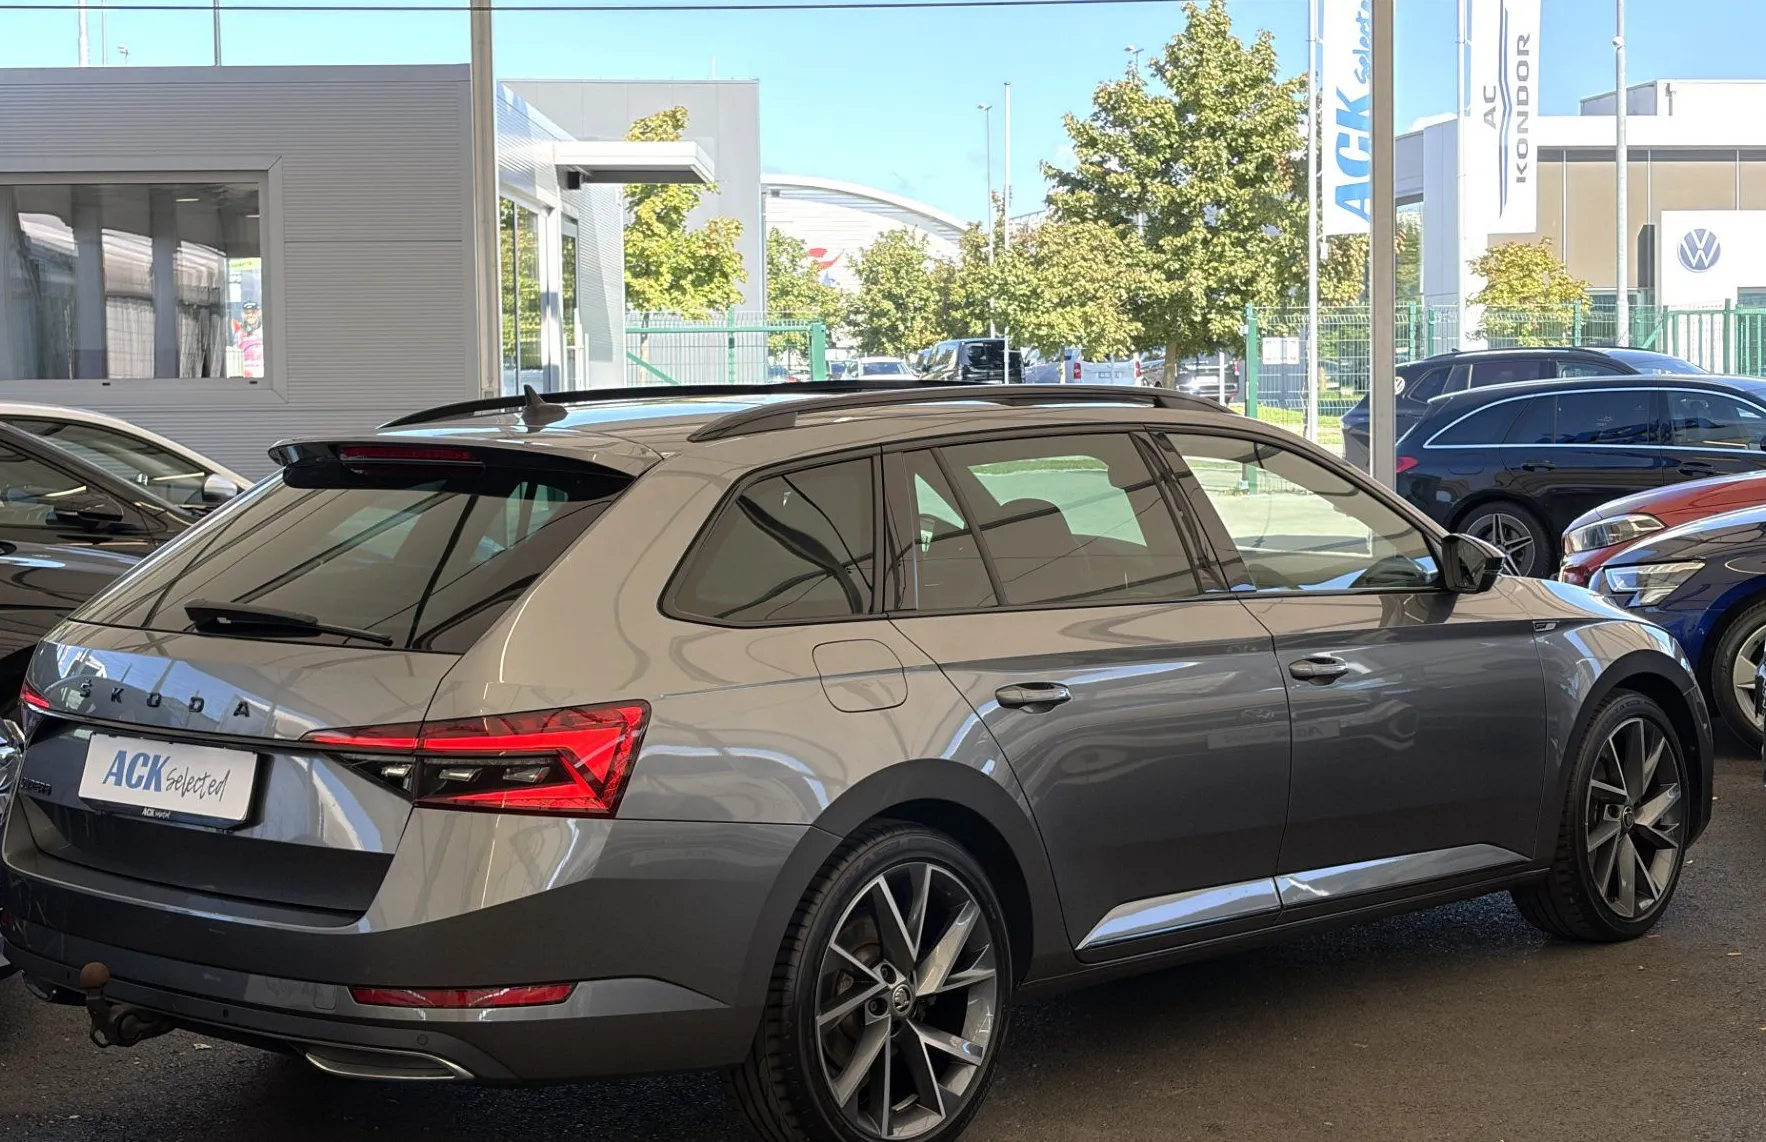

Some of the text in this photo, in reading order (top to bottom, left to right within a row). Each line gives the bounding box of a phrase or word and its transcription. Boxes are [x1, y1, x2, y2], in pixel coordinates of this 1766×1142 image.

[1335, 0, 1371, 223] ACK Selecte
[1483, 85, 1497, 130] AC
[1516, 33, 1531, 183] KONDOR
[1678, 228, 1721, 272] VW
[79, 679, 250, 718] ŠKODA
[102, 750, 231, 803] ACK Selected
